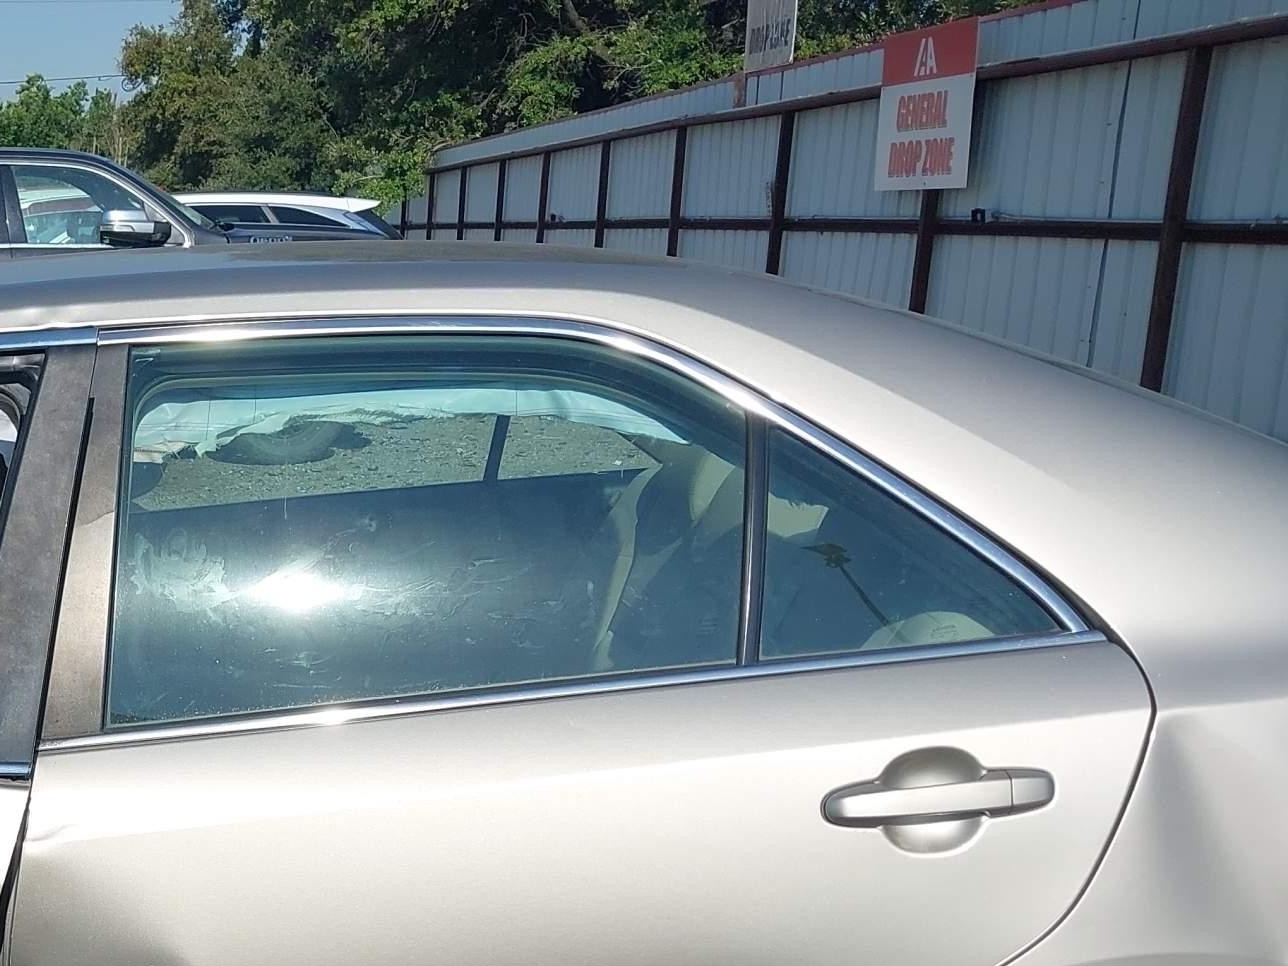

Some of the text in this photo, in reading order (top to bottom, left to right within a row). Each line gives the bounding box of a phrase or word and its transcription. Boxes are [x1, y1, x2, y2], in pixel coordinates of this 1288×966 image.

[896, 90, 949, 132] GENERAL
[887, 137, 955, 178] DROP ZONE
